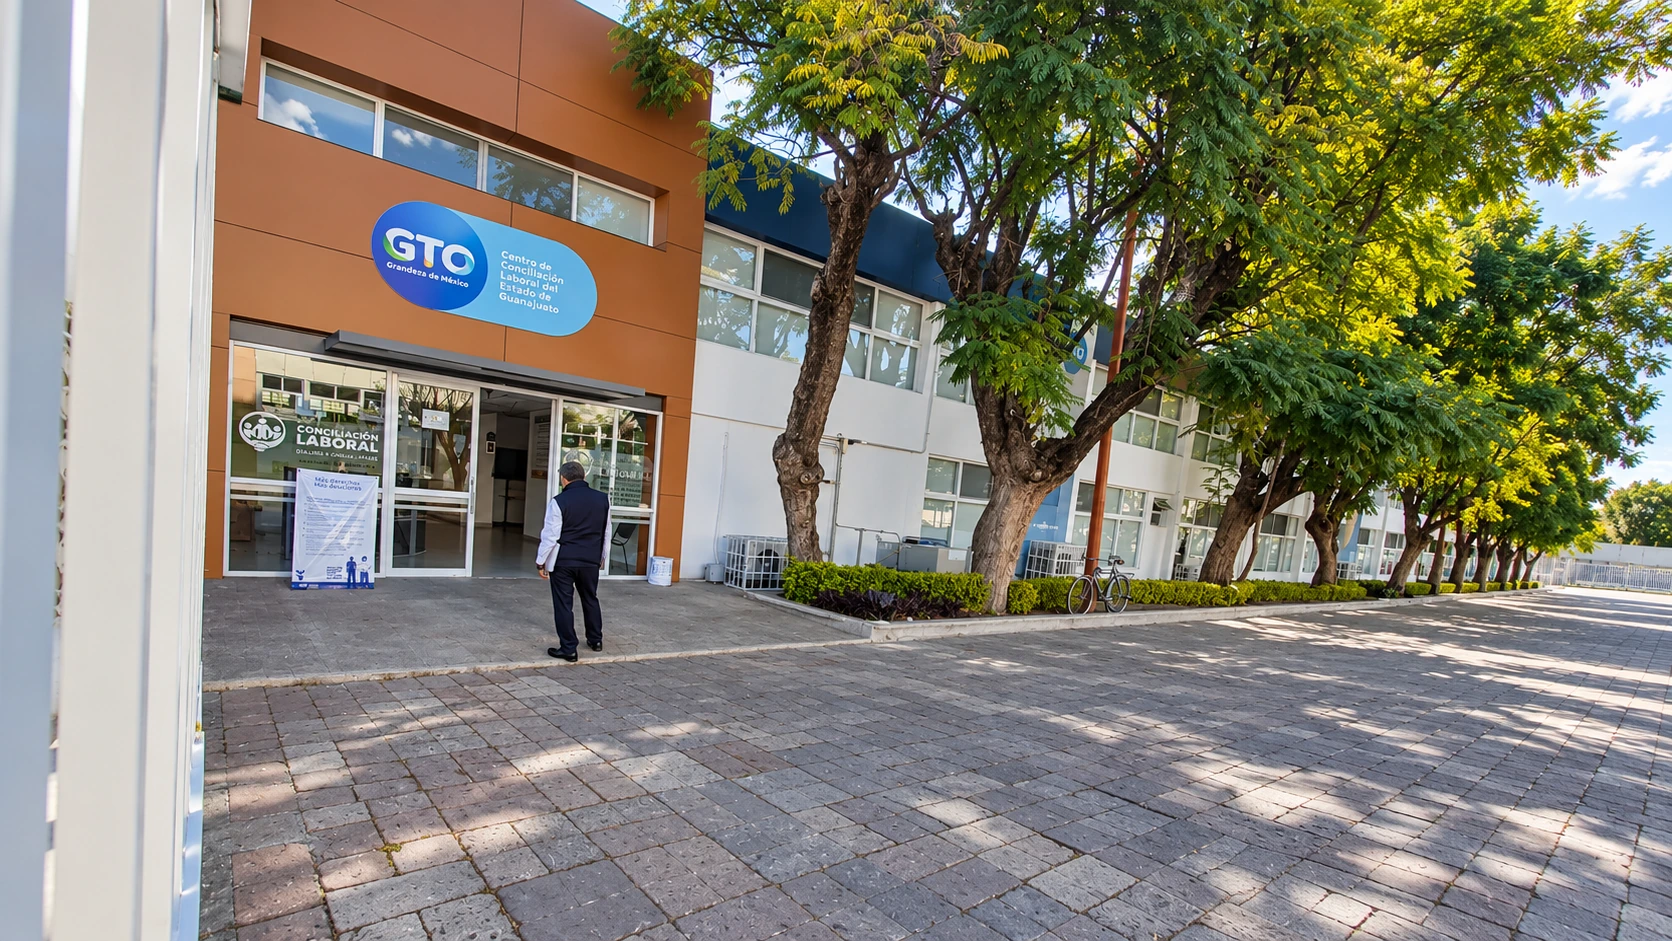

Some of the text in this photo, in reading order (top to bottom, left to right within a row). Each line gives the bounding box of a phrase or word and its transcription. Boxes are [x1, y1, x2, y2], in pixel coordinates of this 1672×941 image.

[383, 228, 475, 276] GTO
[501, 250, 552, 271] Centro de
[386, 261, 469, 288] Grandeza de México
[500, 271, 558, 293] Laboral del
[501, 261, 564, 284] Conciliación
[499, 292, 560, 314] Guanajuato
[500, 282, 551, 302] Estado de
[296, 433, 379, 453] LABORAL
[297, 424, 379, 441] CONCILIACIÓN
